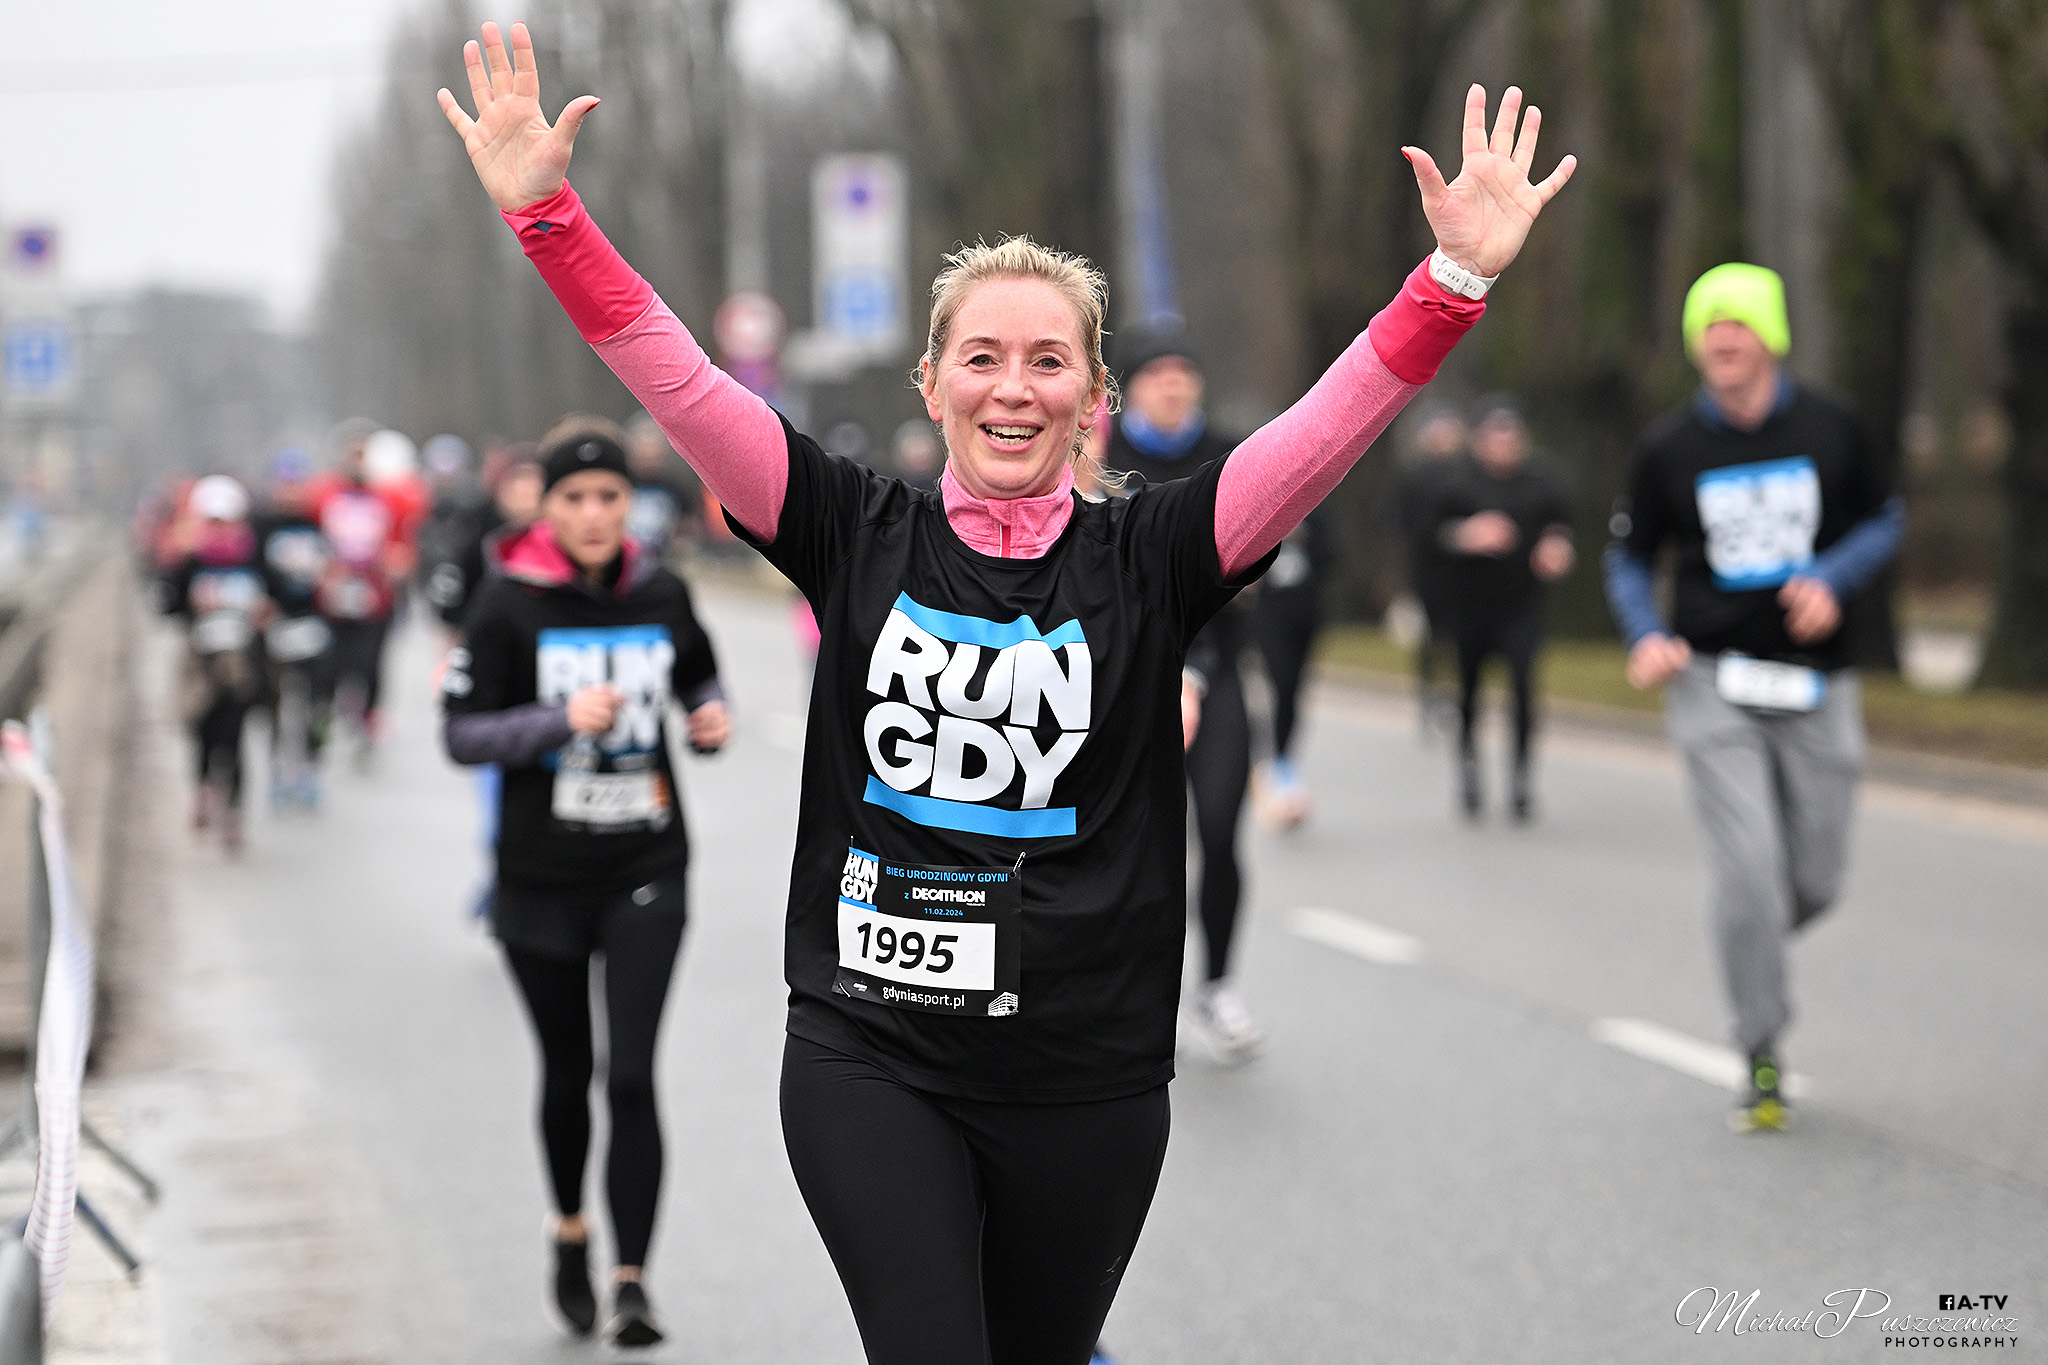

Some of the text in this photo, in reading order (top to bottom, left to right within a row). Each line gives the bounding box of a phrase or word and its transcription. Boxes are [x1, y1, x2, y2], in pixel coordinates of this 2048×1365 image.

[866, 608, 1092, 730] RUN
[864, 701, 1089, 809] GDY
[843, 853, 879, 884] RUN
[886, 866, 1008, 882] BIEG URODZINOWY GDYNI
[840, 875, 878, 905] GDY
[912, 887, 986, 903] DECATHLON
[924, 907, 964, 916] 11.02.2024
[857, 922, 959, 973] 1995
[882, 986, 965, 1009] gdyniasport.pl
